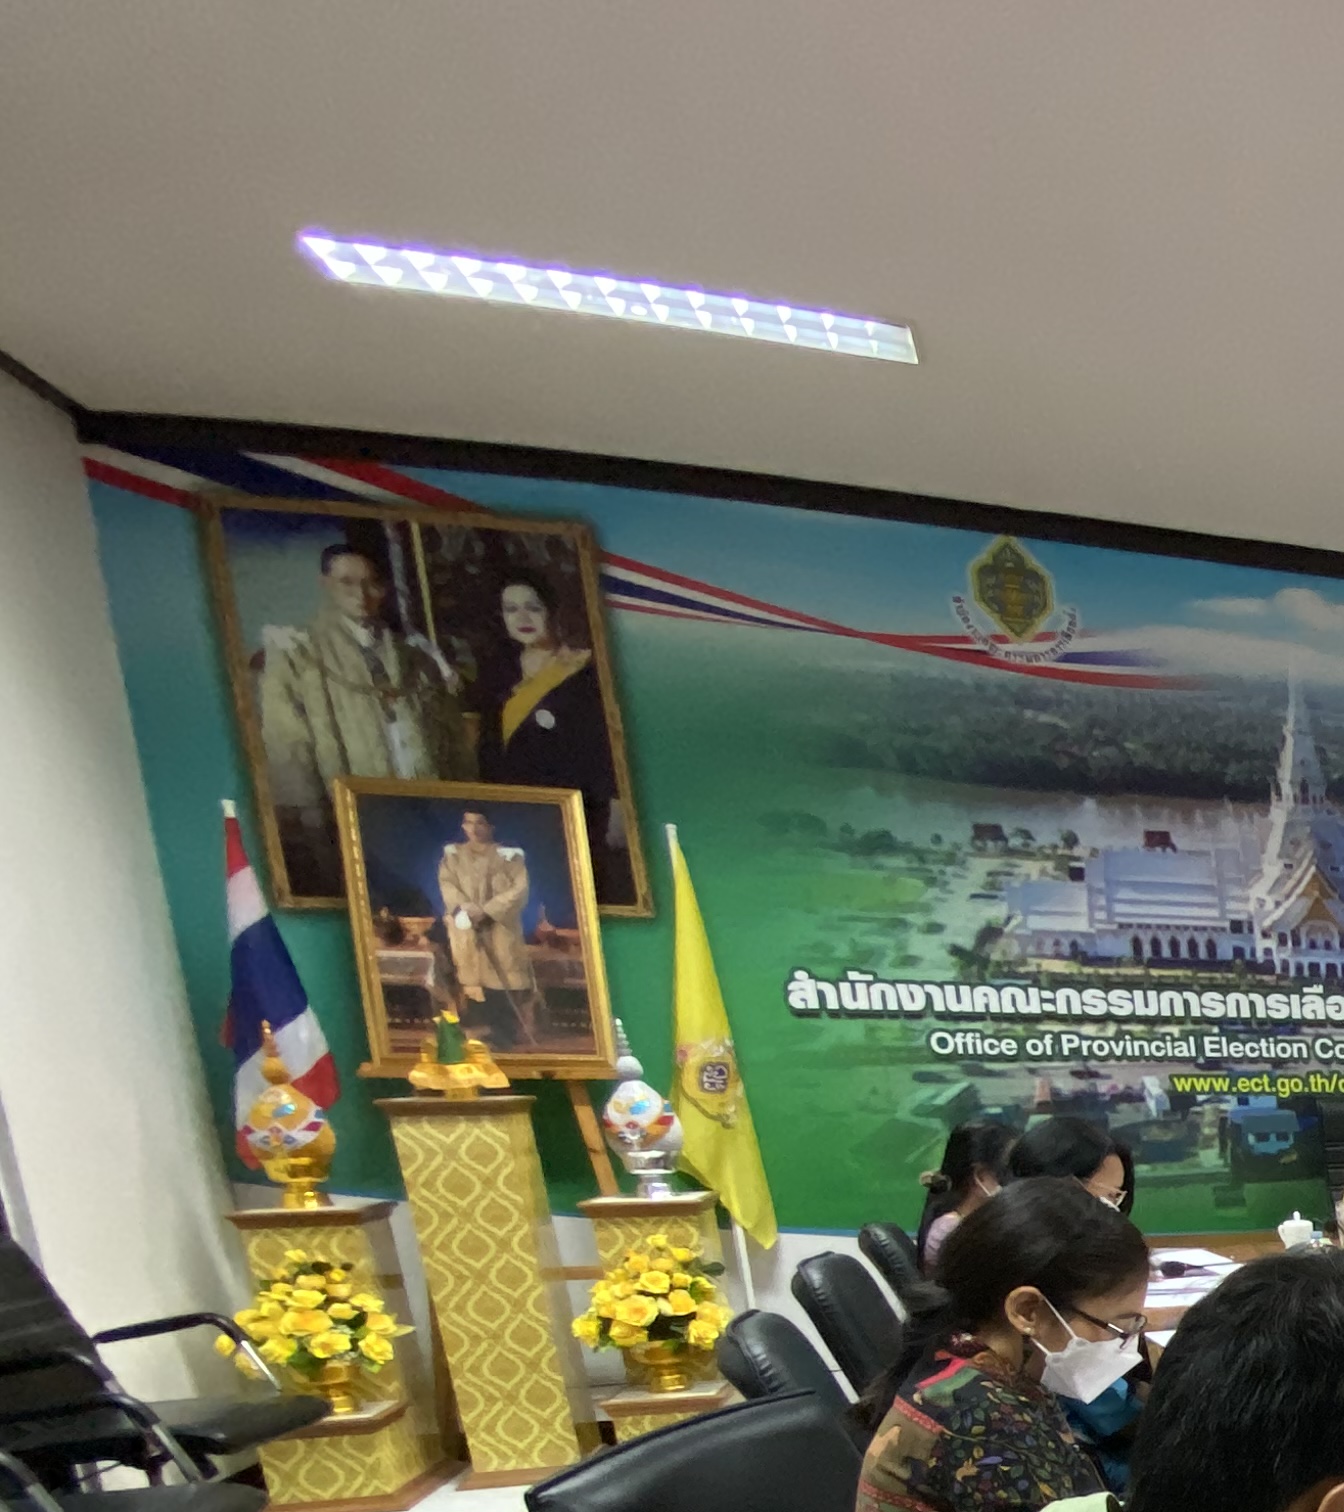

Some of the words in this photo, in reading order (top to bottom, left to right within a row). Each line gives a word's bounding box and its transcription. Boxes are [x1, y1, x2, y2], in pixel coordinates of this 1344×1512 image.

[929, 1031, 1018, 1056] Office
[1025, 1033, 1053, 1056] of
[1060, 1034, 1197, 1058] Provincial
[1204, 1036, 1308, 1060] Election
